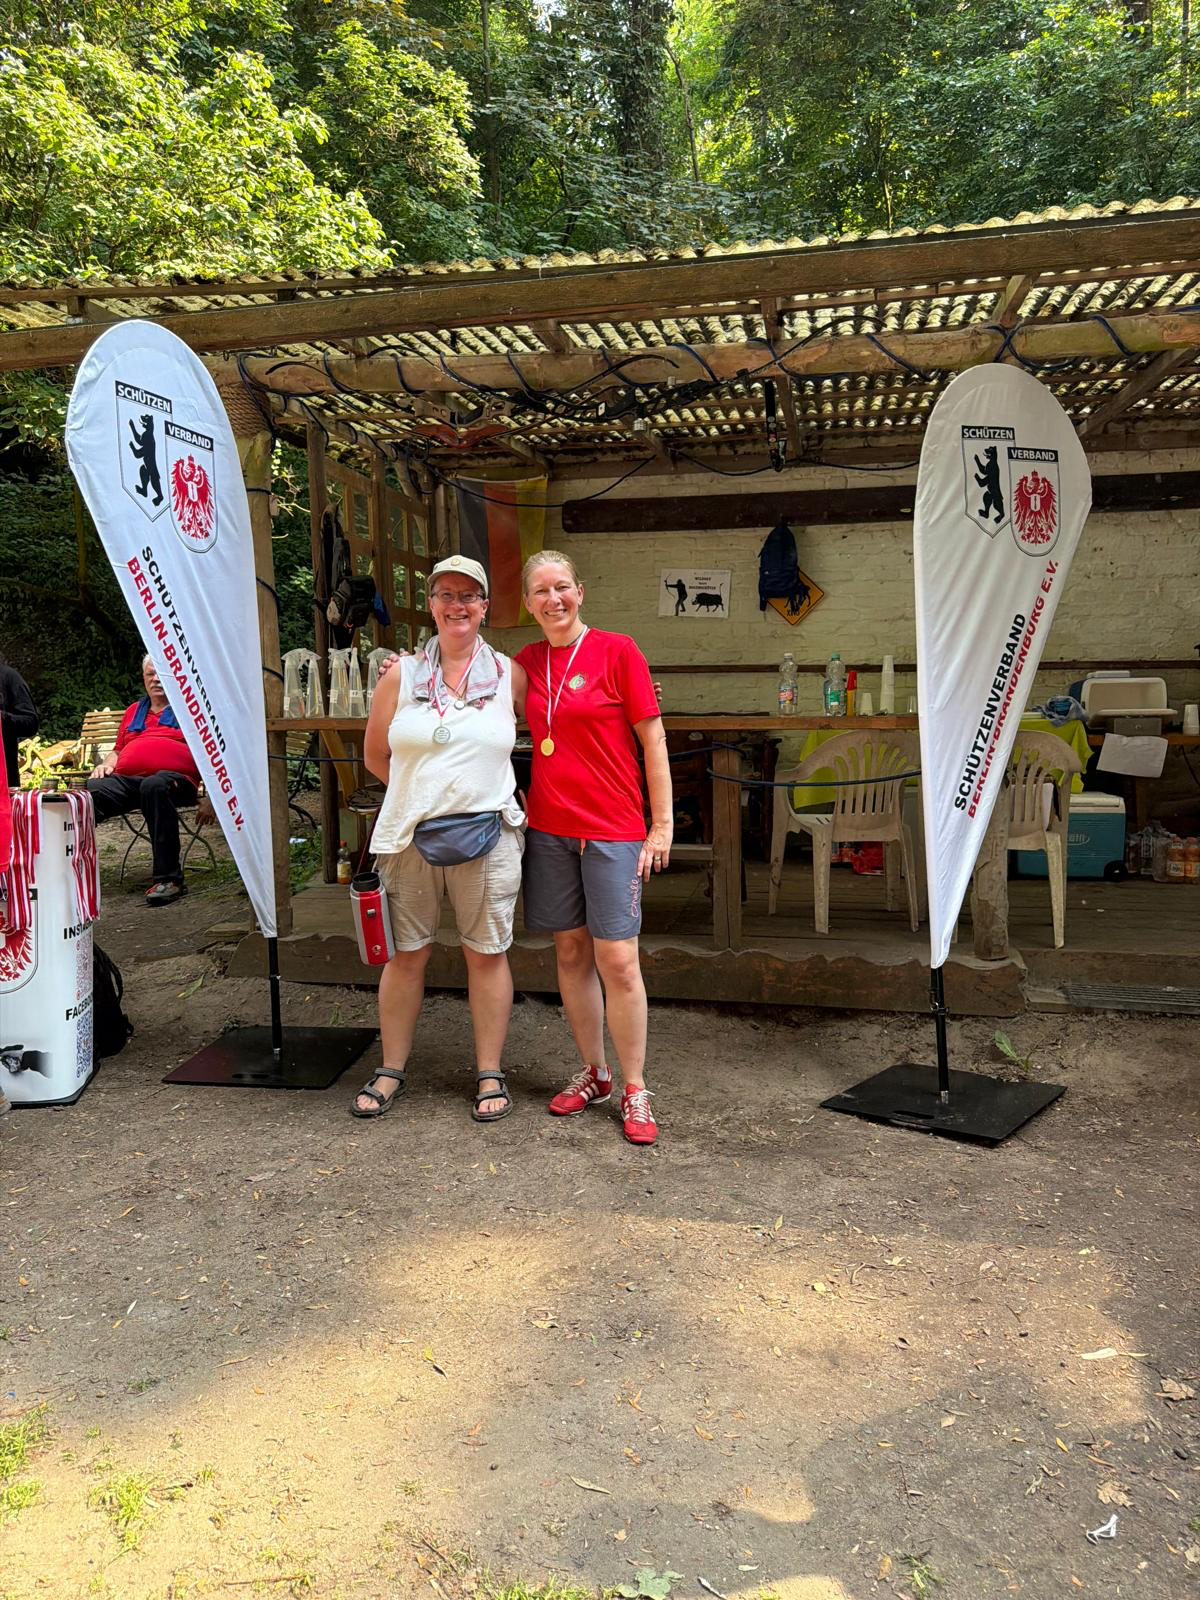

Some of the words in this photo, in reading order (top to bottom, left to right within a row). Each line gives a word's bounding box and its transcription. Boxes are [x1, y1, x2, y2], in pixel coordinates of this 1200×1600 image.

[117, 383, 171, 413] SCHÜTZEN
[167, 423, 212, 449] VERBAND
[963, 426, 1014, 440] SCHÜTZEN
[1010, 449, 1056, 461] VERBAND
[127, 556, 233, 794] BERLIN-BRANDENBURG
[227, 794, 245, 832] E.V.
[967, 595, 1045, 819] BERLIN-BRANDENBURG
[1040, 559, 1059, 593] E.V.
[954, 613, 1026, 811] SCHÜTZENVERBAND
